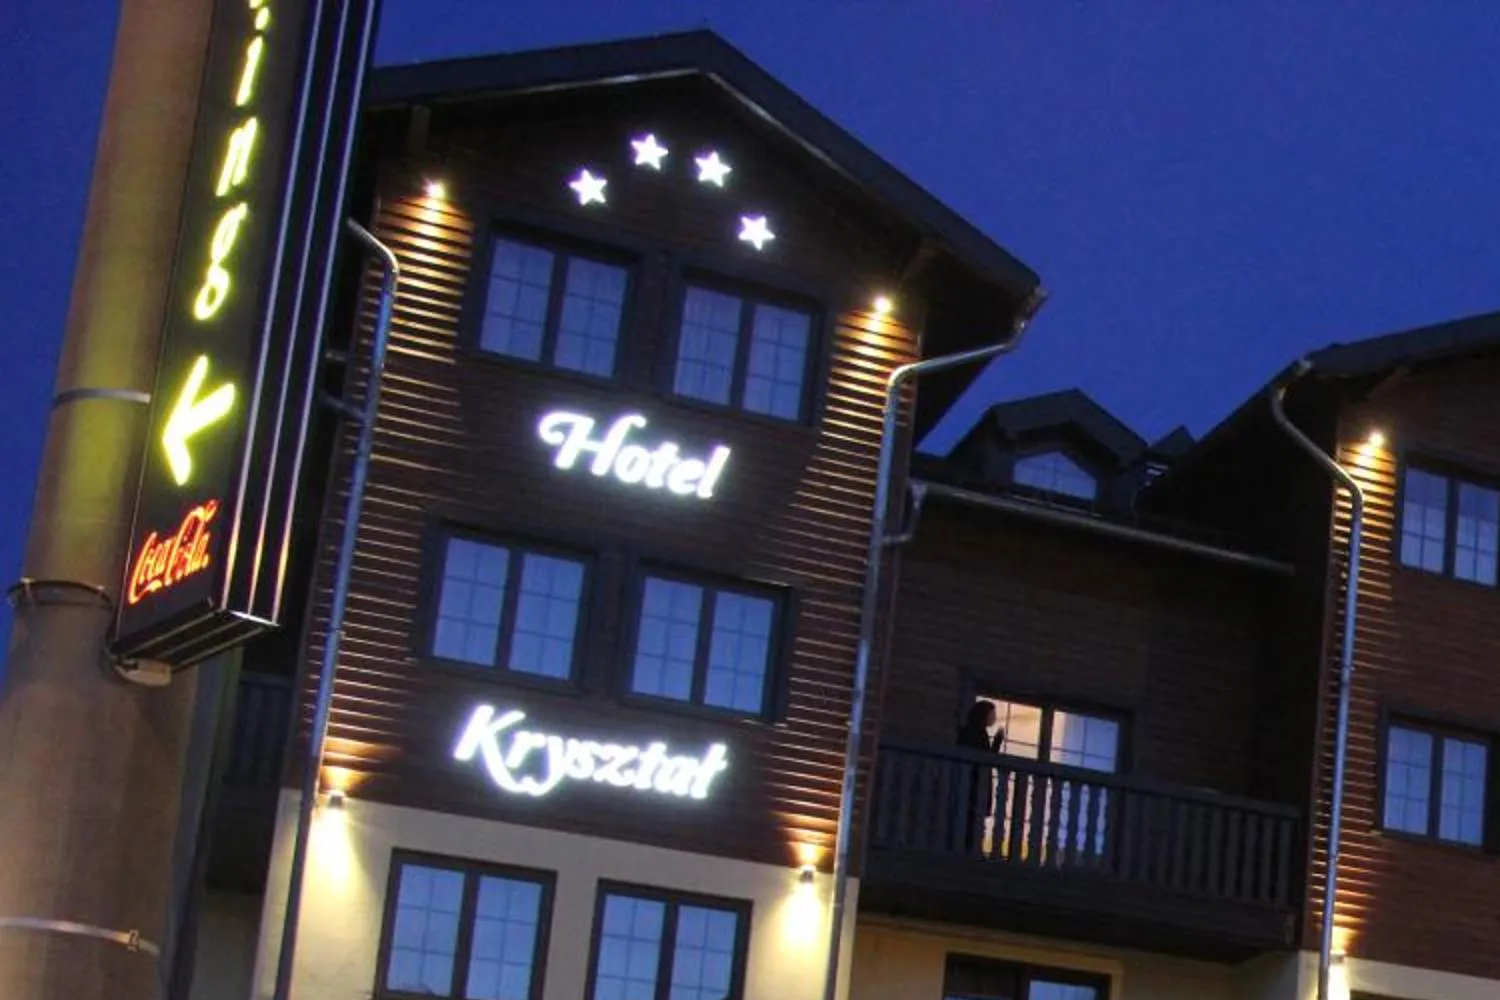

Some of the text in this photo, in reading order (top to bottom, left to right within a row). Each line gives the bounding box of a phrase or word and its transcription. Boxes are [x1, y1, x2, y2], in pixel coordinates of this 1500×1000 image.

[194, 0, 270, 321] ing
[536, 410, 733, 499] Hotel
[453, 703, 729, 800] Kryształ
